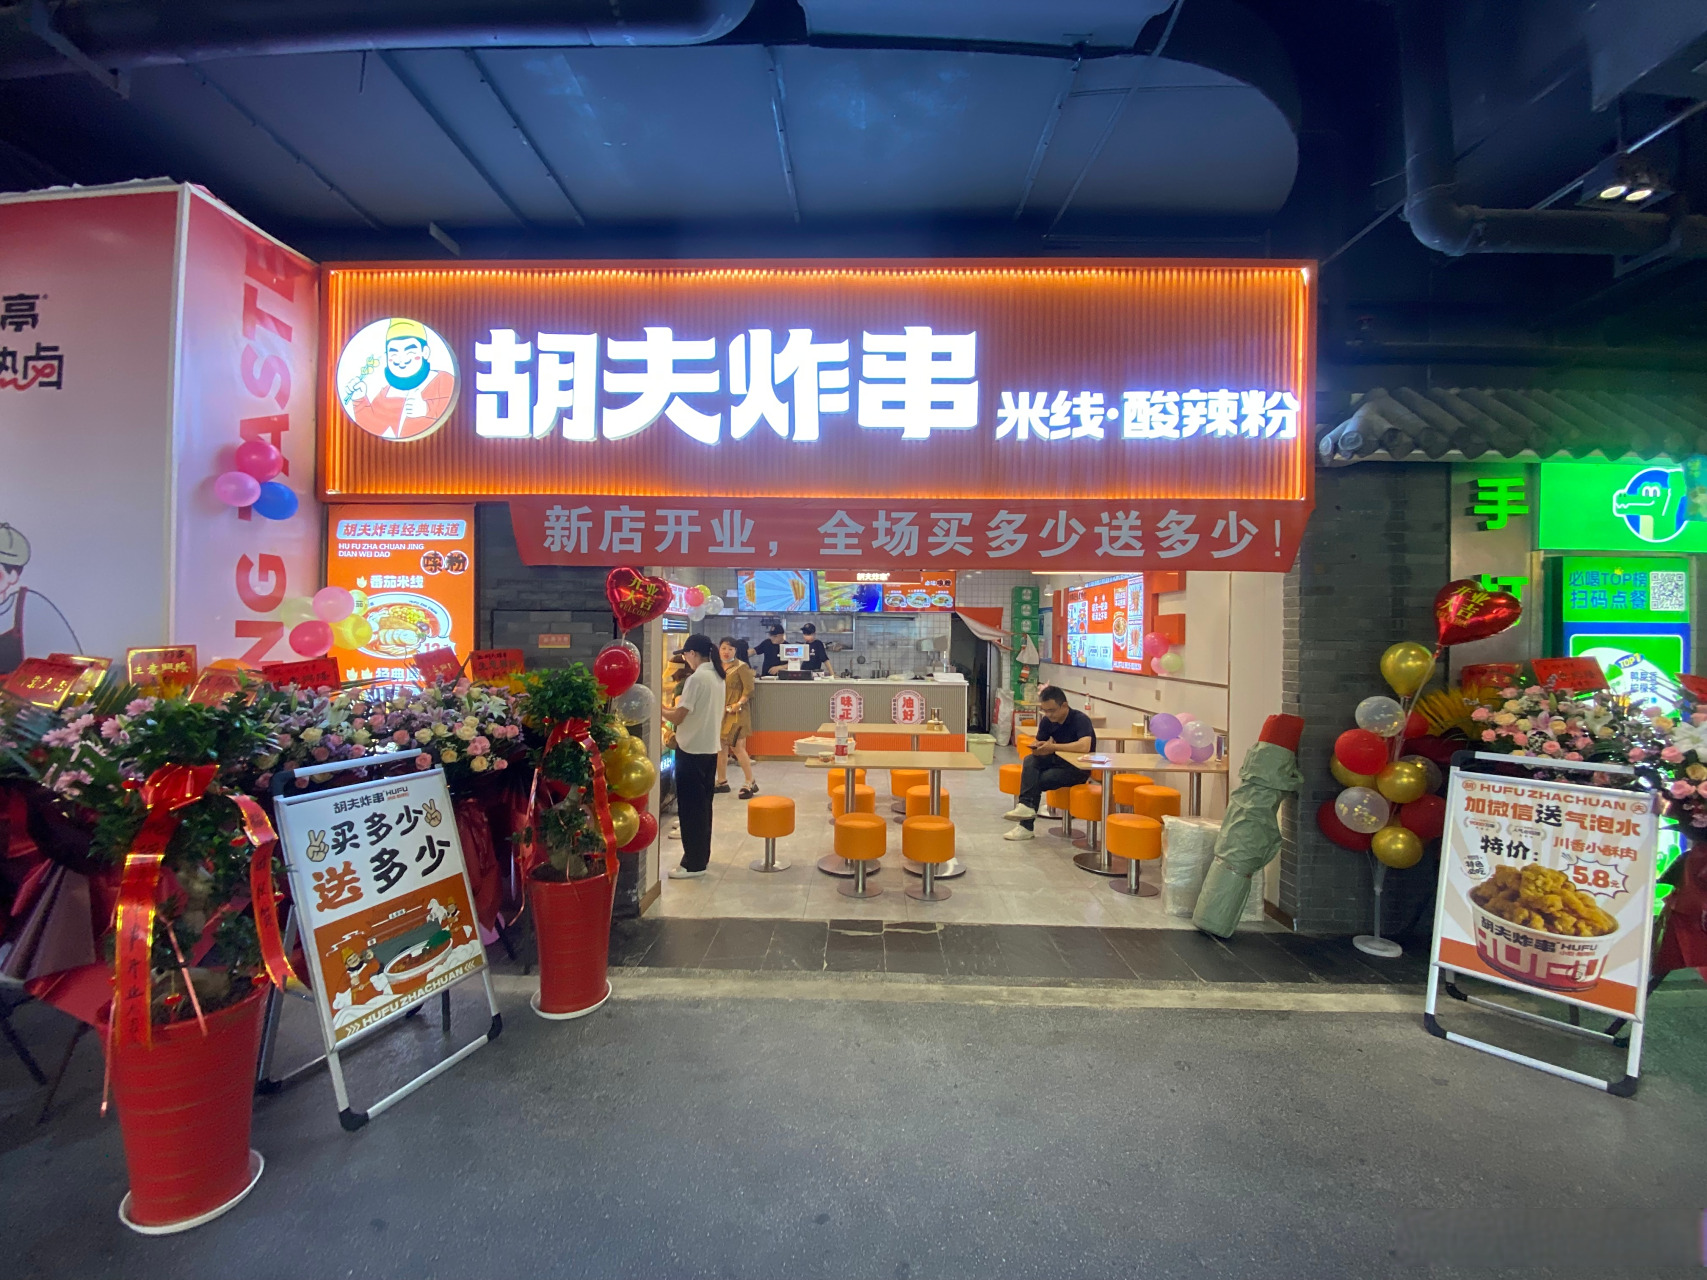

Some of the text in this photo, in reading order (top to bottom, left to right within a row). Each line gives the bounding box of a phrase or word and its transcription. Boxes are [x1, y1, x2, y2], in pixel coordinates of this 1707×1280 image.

[0, 294, 39, 332] 亭
[475, 326, 979, 445] 胡夫炸串
[996, 388, 1300, 441] 米线·酸辣粉
[343, 523, 460, 537] 胡夫炸串经典味道
[370, 575, 424, 588] 番茄米线
[1569, 570, 1648, 587] 必喝TOP榜
[1570, 590, 1647, 609] 扫码点餐
[333, 793, 385, 814] 胡夫炸串
[386, 786, 408, 796] HUFU
[1480, 783, 1525, 797] HUFU
[1527, 789, 1627, 811] ZHACHUAN
[331, 805, 423, 855] 买多少
[1464, 796, 1641, 837] 加微信送气泡水
[1480, 835, 1539, 861] 特价：
[1554, 836, 1638, 861] 川香小酥肉
[312, 835, 450, 912] 送多少
[1481, 916, 1598, 953] 胡夫炸串 HUFU
[363, 968, 464, 1027] HUFU ZHACHUAN
